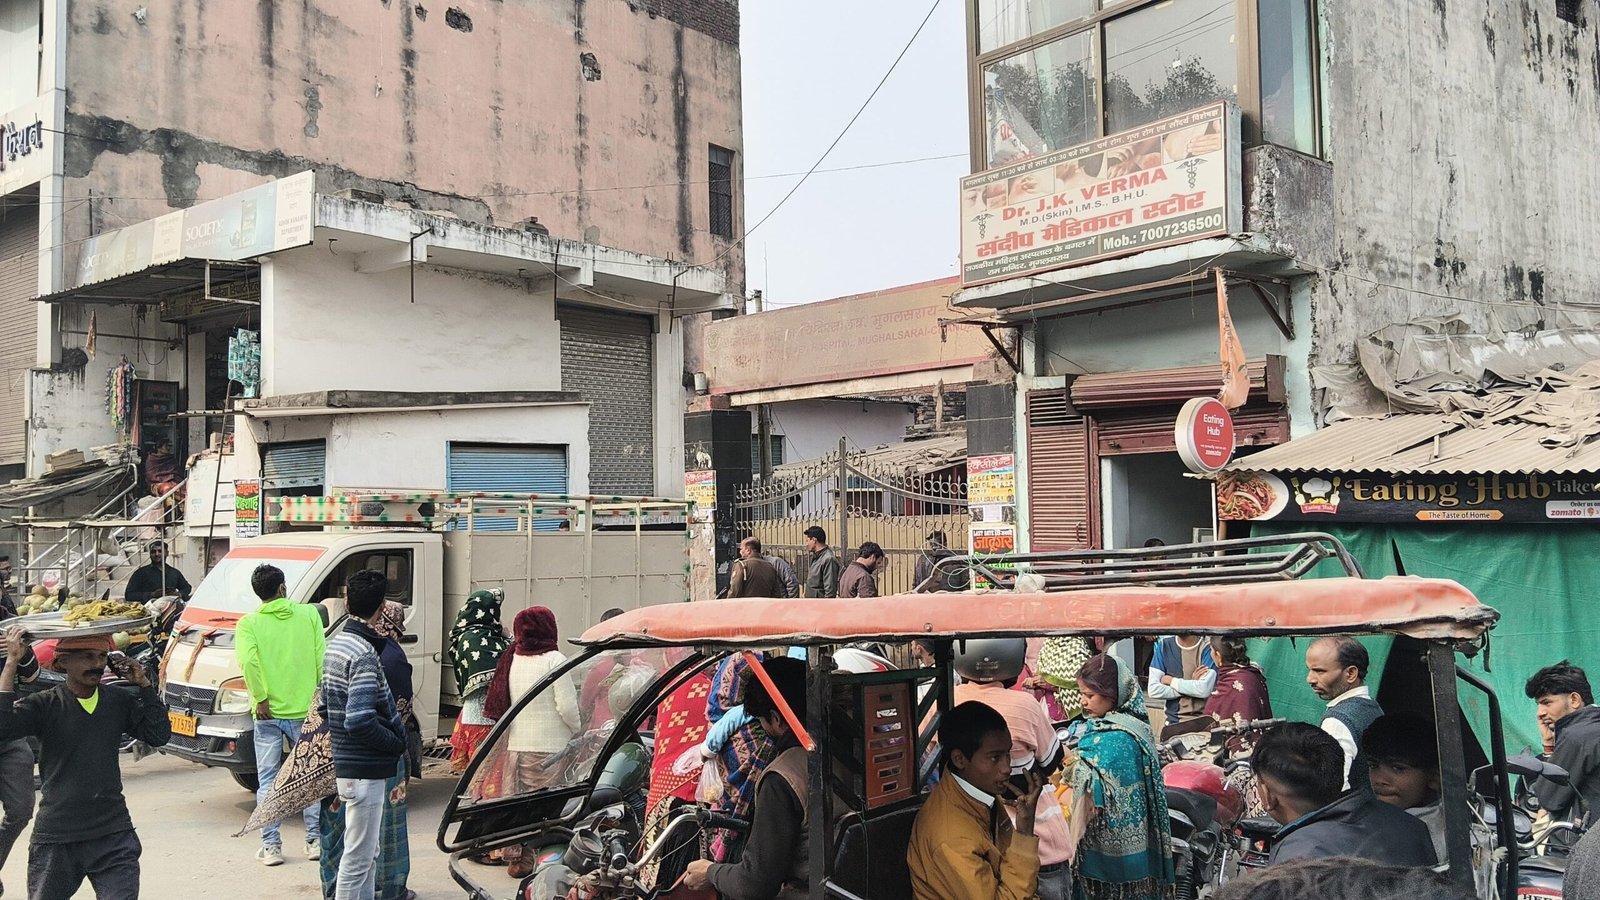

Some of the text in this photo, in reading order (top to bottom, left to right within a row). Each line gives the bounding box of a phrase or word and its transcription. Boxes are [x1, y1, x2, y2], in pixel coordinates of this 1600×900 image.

[1142, 127, 1154, 137] रोग
[1001, 169, 1016, 179] 11:30
[1049, 154, 1067, 164] 03:30
[1002, 168, 1168, 221] Dr. J.K. VERMA
[1019, 208, 1073, 227] M.D.(Skin)
[1111, 188, 1149, 205] B.H.U.
[976, 190, 1206, 257] संदीप मेडिकल स्टोर
[1103, 213, 1222, 250] Mob.: 7007236500
[995, 254, 1019, 266] महिला
[1020, 248, 1053, 261] अस्पताल
[1054, 245, 1063, 253] के
[1064, 240, 1087, 251] बगल
[1087, 236, 1097, 245] में
[1029, 253, 1070, 269] मुगलसराय
[1203, 413, 1225, 427] Eating
[1207, 426, 1221, 436] Hub
[1345, 477, 1460, 507] Eating
[1466, 473, 1551, 505] Hub
[1428, 511, 1490, 519] The Taste of Home
[974, 536, 1013, 552] जादूगर
